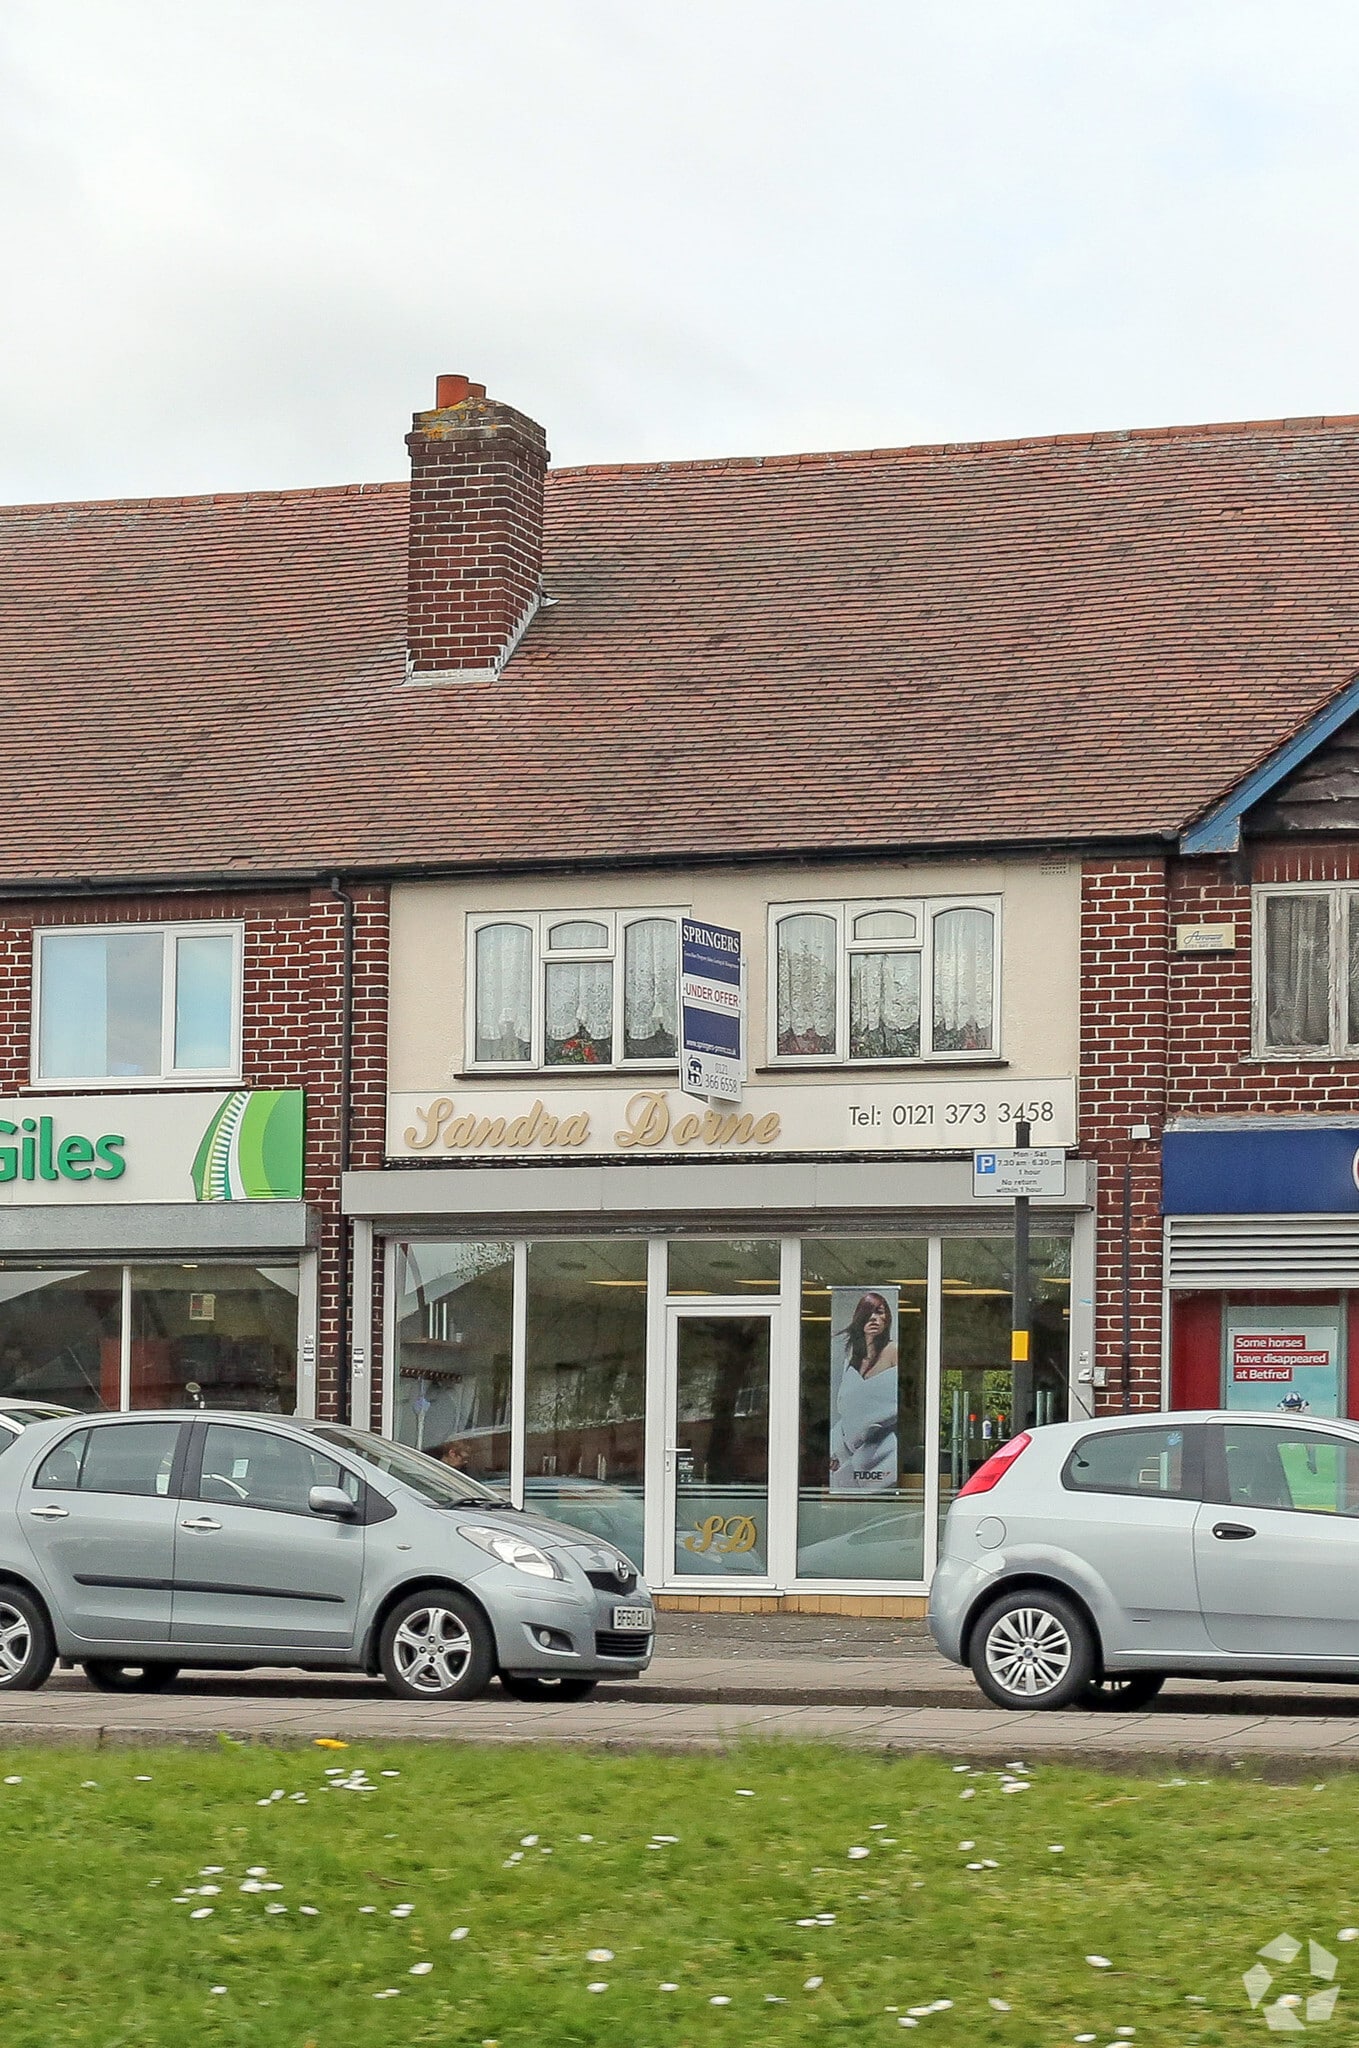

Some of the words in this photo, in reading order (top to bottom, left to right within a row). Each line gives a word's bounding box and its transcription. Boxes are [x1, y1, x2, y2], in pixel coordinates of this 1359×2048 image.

[683, 925, 739, 953] SPRINGERS
[686, 983, 713, 1000] UNDER
[714, 990, 739, 1007] OFFER
[404, 1096, 591, 1149] Sandra
[614, 1091, 781, 1147] Dorne
[849, 1105, 881, 1125] Tel:
[893, 1105, 934, 1125] 0121
[945, 1104, 987, 1124] 373
[998, 1102, 1054, 1122] 3458
[980, 1156, 993, 1172] P
[1236, 1338, 1267, 1347] Some
[1268, 1337, 1303, 1347] horses
[1236, 1354, 1261, 1363] have
[1263, 1353, 1327, 1365] disappeared
[1236, 1370, 1248, 1379] at
[1249, 1369, 1290, 1379] Betfred
[853, 1471, 883, 1480] FUDGE
